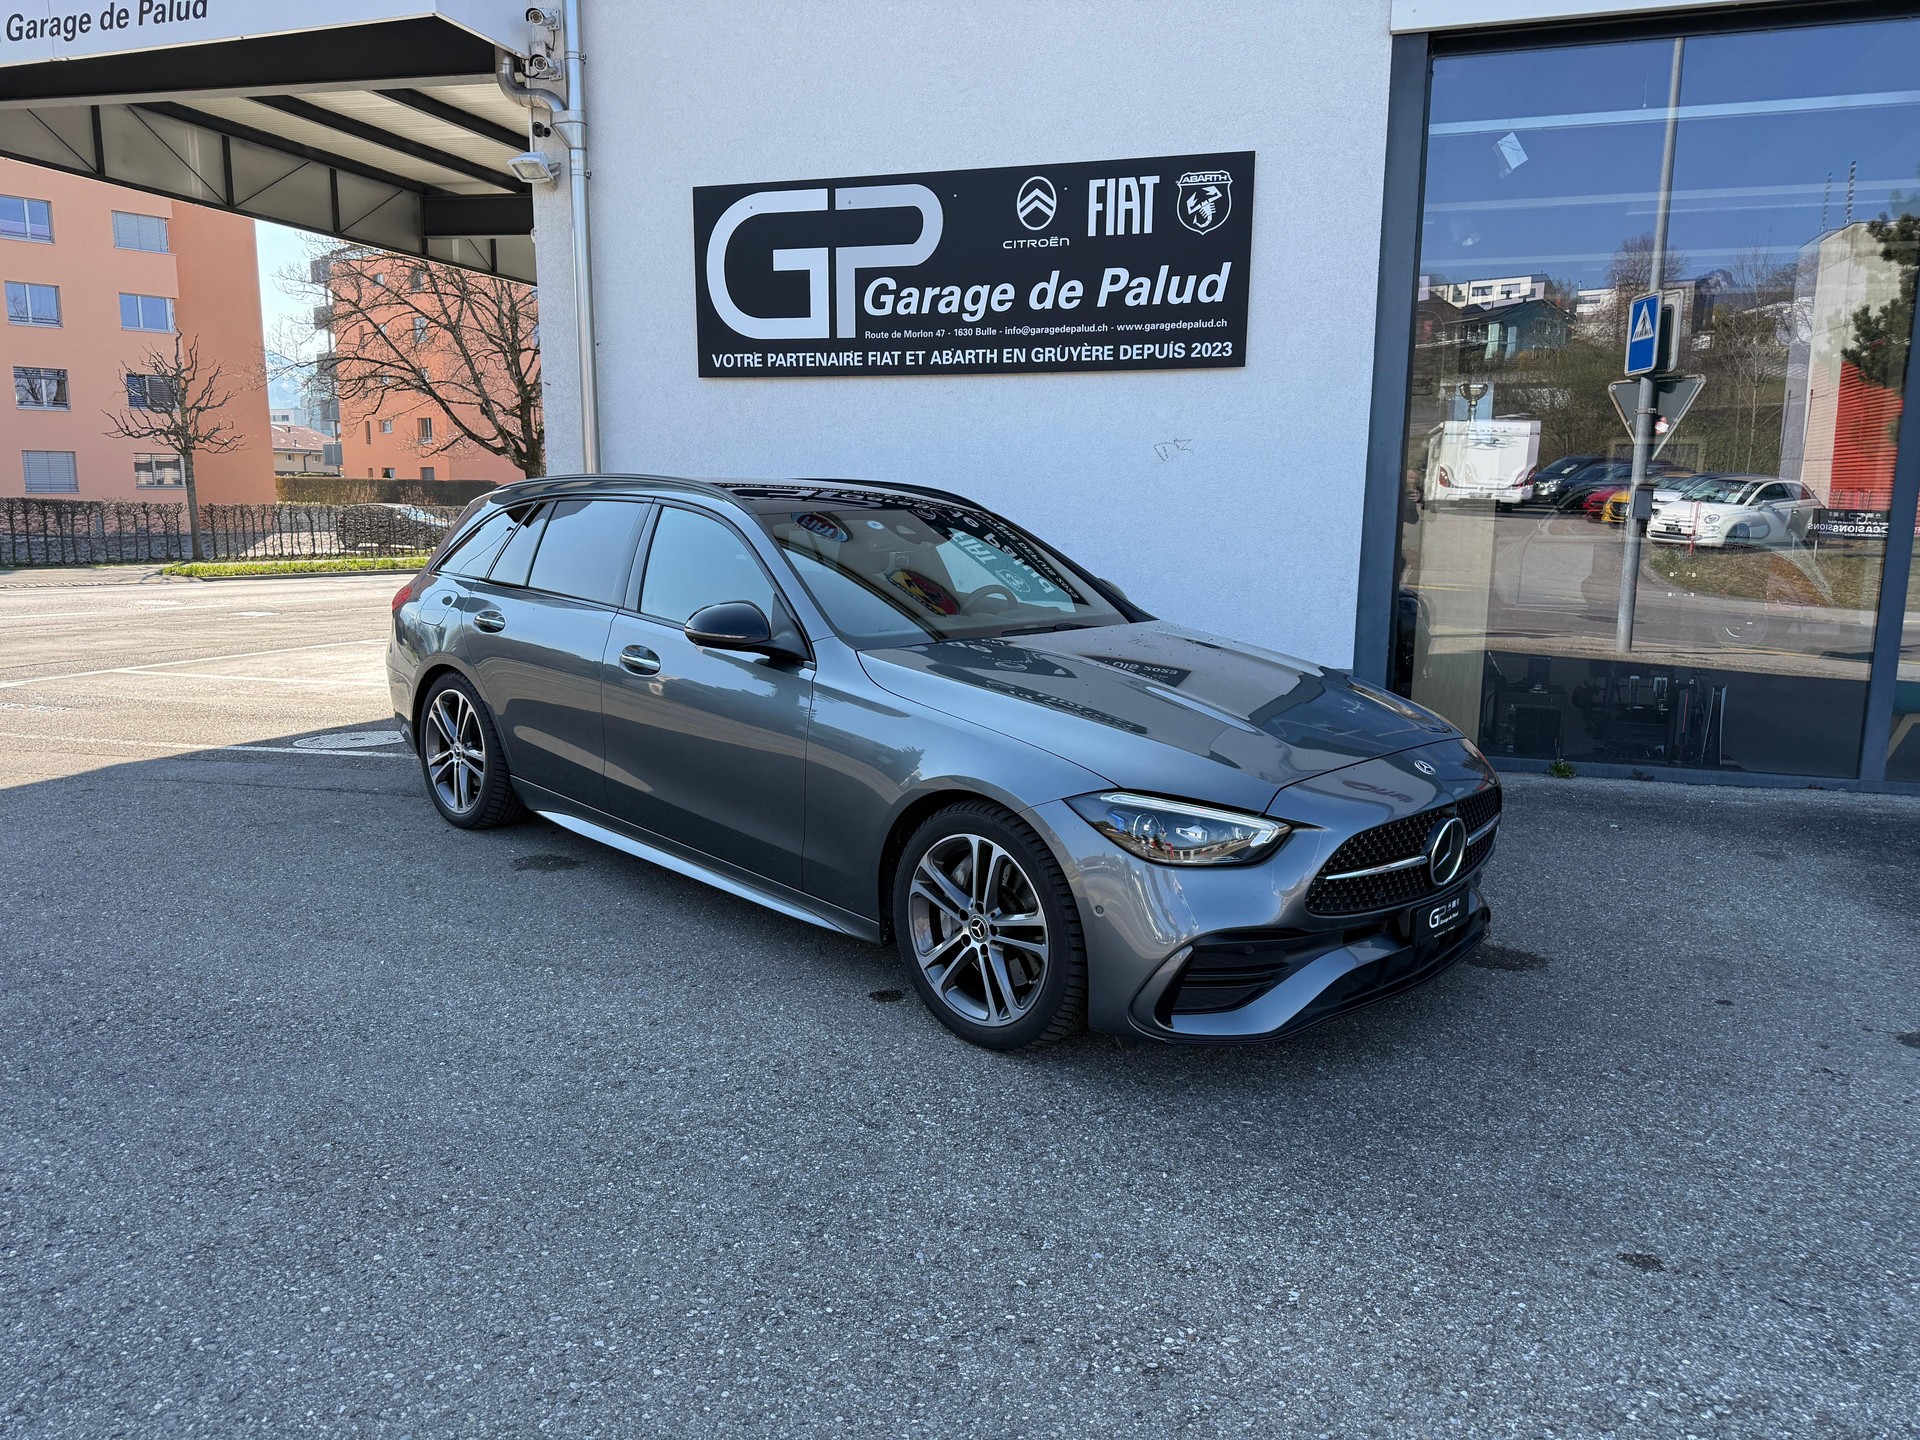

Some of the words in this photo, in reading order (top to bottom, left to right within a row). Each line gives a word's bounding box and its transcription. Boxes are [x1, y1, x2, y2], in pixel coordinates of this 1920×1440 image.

[6, 13, 91, 42] Garage
[100, 2, 130, 31] de
[138, 0, 208, 26] Palud
[1182, 173, 1228, 184] ABARTH
[1088, 175, 1160, 237] FIAT
[706, 183, 945, 340] GP
[864, 276, 1016, 323] Garage
[1029, 270, 1084, 310] de
[1097, 261, 1233, 308] Palud
[865, 330, 889, 340] Route
[890, 330, 902, 339] de
[903, 328, 934, 339] Morlon
[936, 329, 946, 338] 47
[954, 328, 974, 337] 1630
[975, 326, 997, 337] Bulle
[1005, 323, 1108, 336] info@garagedepalud.ch
[1117, 319, 1228, 332] www.garagedepalud.ch
[712, 352, 762, 368] VOTRE
[768, 350, 863, 367] PARTENAIRE
[868, 351, 902, 366] FIAT
[906, 350, 926, 366] ET
[930, 348, 998, 366] ABARTH
[1003, 348, 1027, 364] EN
[1031, 343, 1115, 363] GRUYÈRE
[1120, 341, 1186, 361] DEPUIS
[1191, 341, 1233, 358] 2023
[1429, 904, 1447, 929] GP
